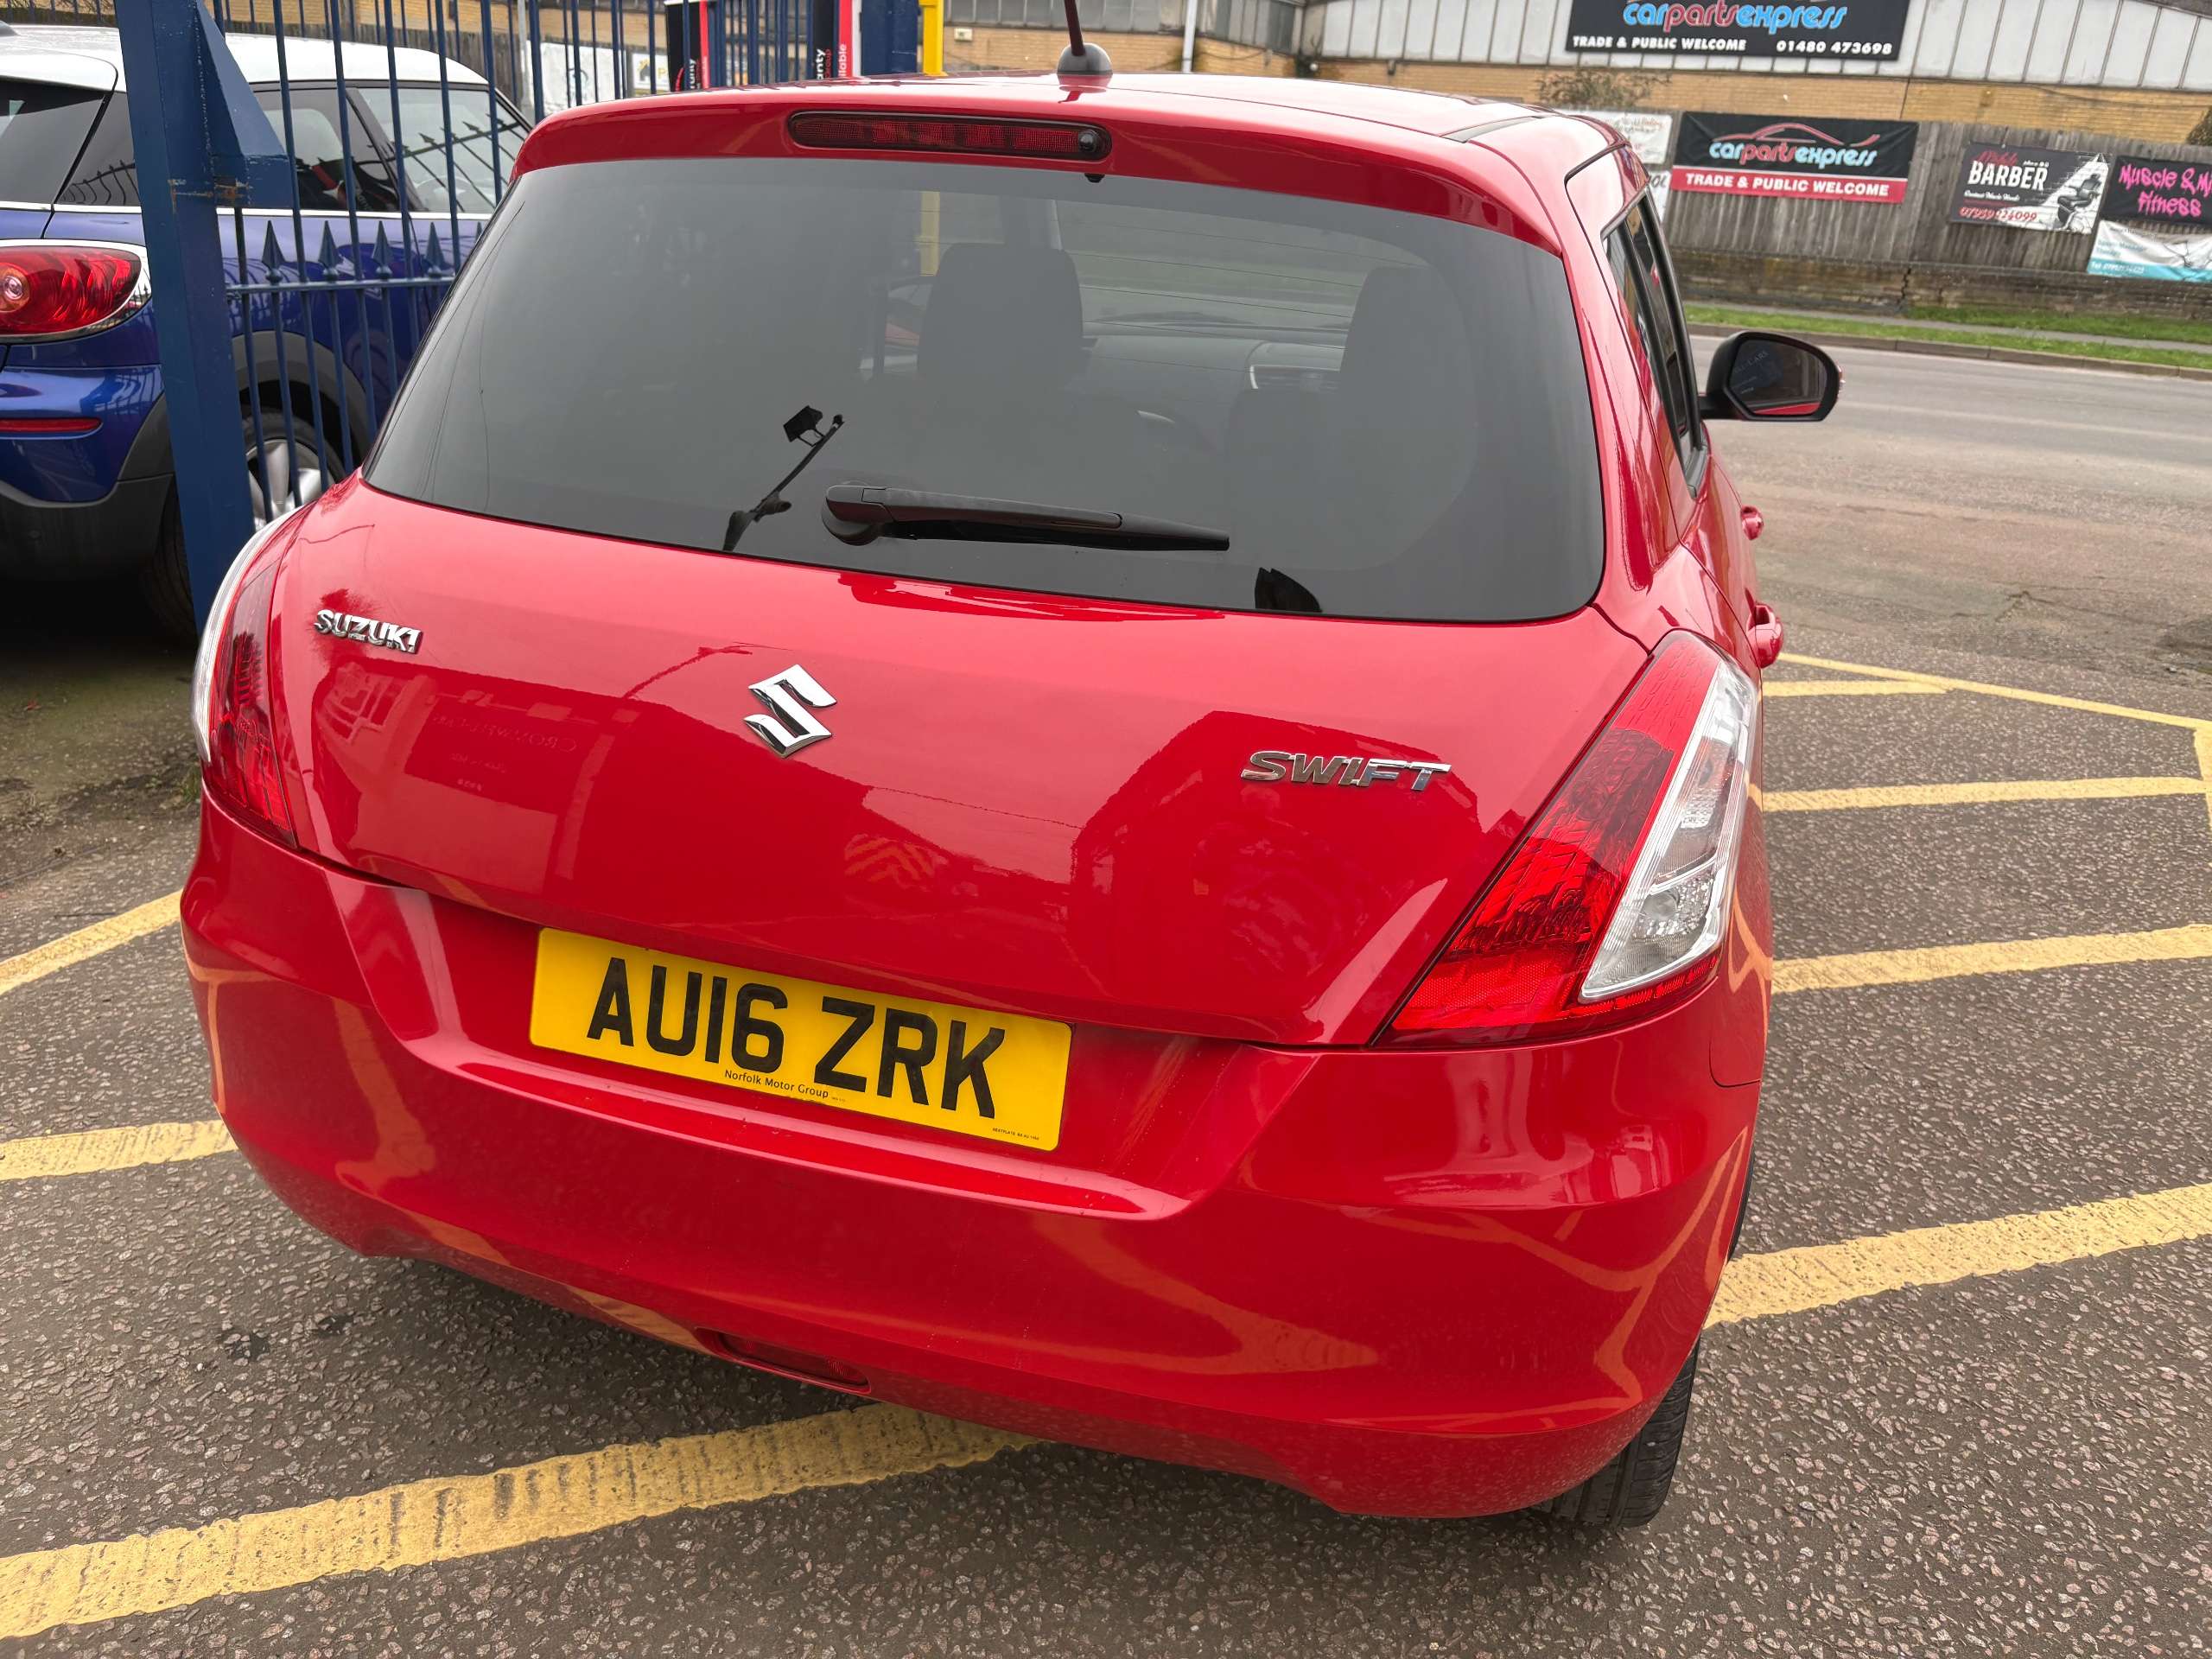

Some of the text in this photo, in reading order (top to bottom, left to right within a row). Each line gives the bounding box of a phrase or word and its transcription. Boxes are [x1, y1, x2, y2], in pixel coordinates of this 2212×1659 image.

[1573, 36, 1893, 55] TRADE & PUBLIC WELCOME 01480 473698
[1685, 173, 1890, 196] TRADE & PUBLIC WELCOME
[1967, 160, 2049, 190] BARBER
[2118, 163, 2178, 190] Muscle
[2180, 167, 2196, 195] &
[314, 609, 423, 654] SUZUKI
[1241, 751, 1452, 791] SWIFT
[586, 957, 1006, 1119] AU16 ZRK
[724, 1069, 830, 1099] Norfolk Motor Group
